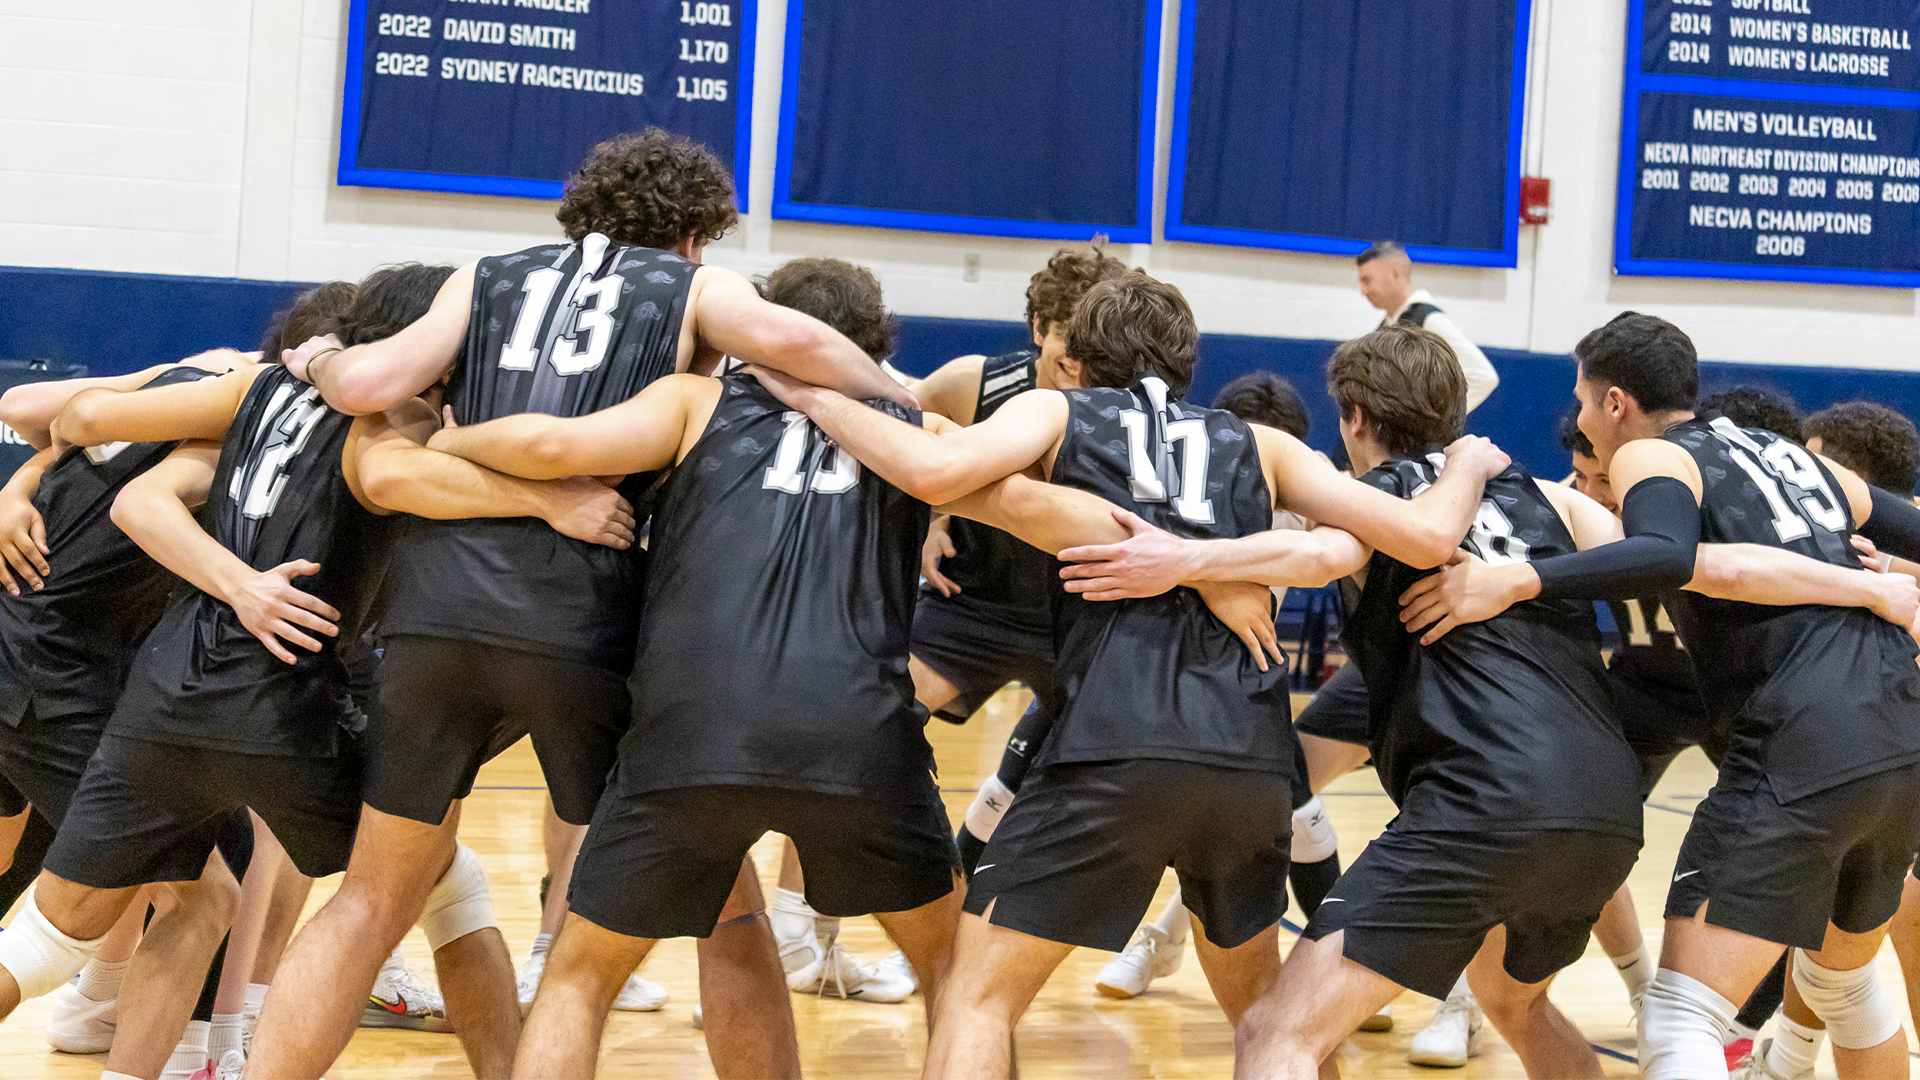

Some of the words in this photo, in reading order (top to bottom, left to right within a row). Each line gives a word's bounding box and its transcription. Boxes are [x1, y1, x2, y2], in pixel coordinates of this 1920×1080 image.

[378, 13, 432, 39] 2022
[443, 18, 506, 45] DAVID
[509, 23, 576, 51] SMITH
[680, 1, 732, 27] 1,001
[1670, 12, 1712, 36] 2014
[1729, 17, 1808, 43] WOMEN'S
[1811, 23, 1912, 50] BASKETBALL
[679, 38, 729, 64] 1,170
[1668, 40, 1710, 64] 2014
[1728, 45, 1807, 71] WOMEN'S
[1810, 52, 1890, 77] LACROSSE
[375, 52, 429, 77] 2022
[440, 57, 520, 84] SYDNEY
[521, 63, 644, 96] RACEVICIUS
[676, 76, 728, 102] 1,105
[1693, 108, 1758, 134] MEN'S
[1761, 113, 1877, 141] VOLLEYBALL
[1644, 142, 1690, 164] NECVA
[1691, 145, 1773, 170] NORTHEAST
[1773, 149, 1839, 173] DIVISION
[1840, 153, 1920, 178] CHAMPIONS
[1642, 169, 1680, 190] 2001
[1690, 171, 1730, 193] 2002
[1738, 174, 1779, 196] 2003
[1788, 177, 1826, 198] 2004
[1836, 180, 1874, 201] 2005
[1689, 205, 1753, 229] NECVA
[1756, 209, 1872, 235] CHAMPIONS
[1756, 235, 1806, 256] 2006
[498, 267, 625, 376] 13
[1118, 408, 1216, 525] 17
[1728, 438, 1848, 544] 19
